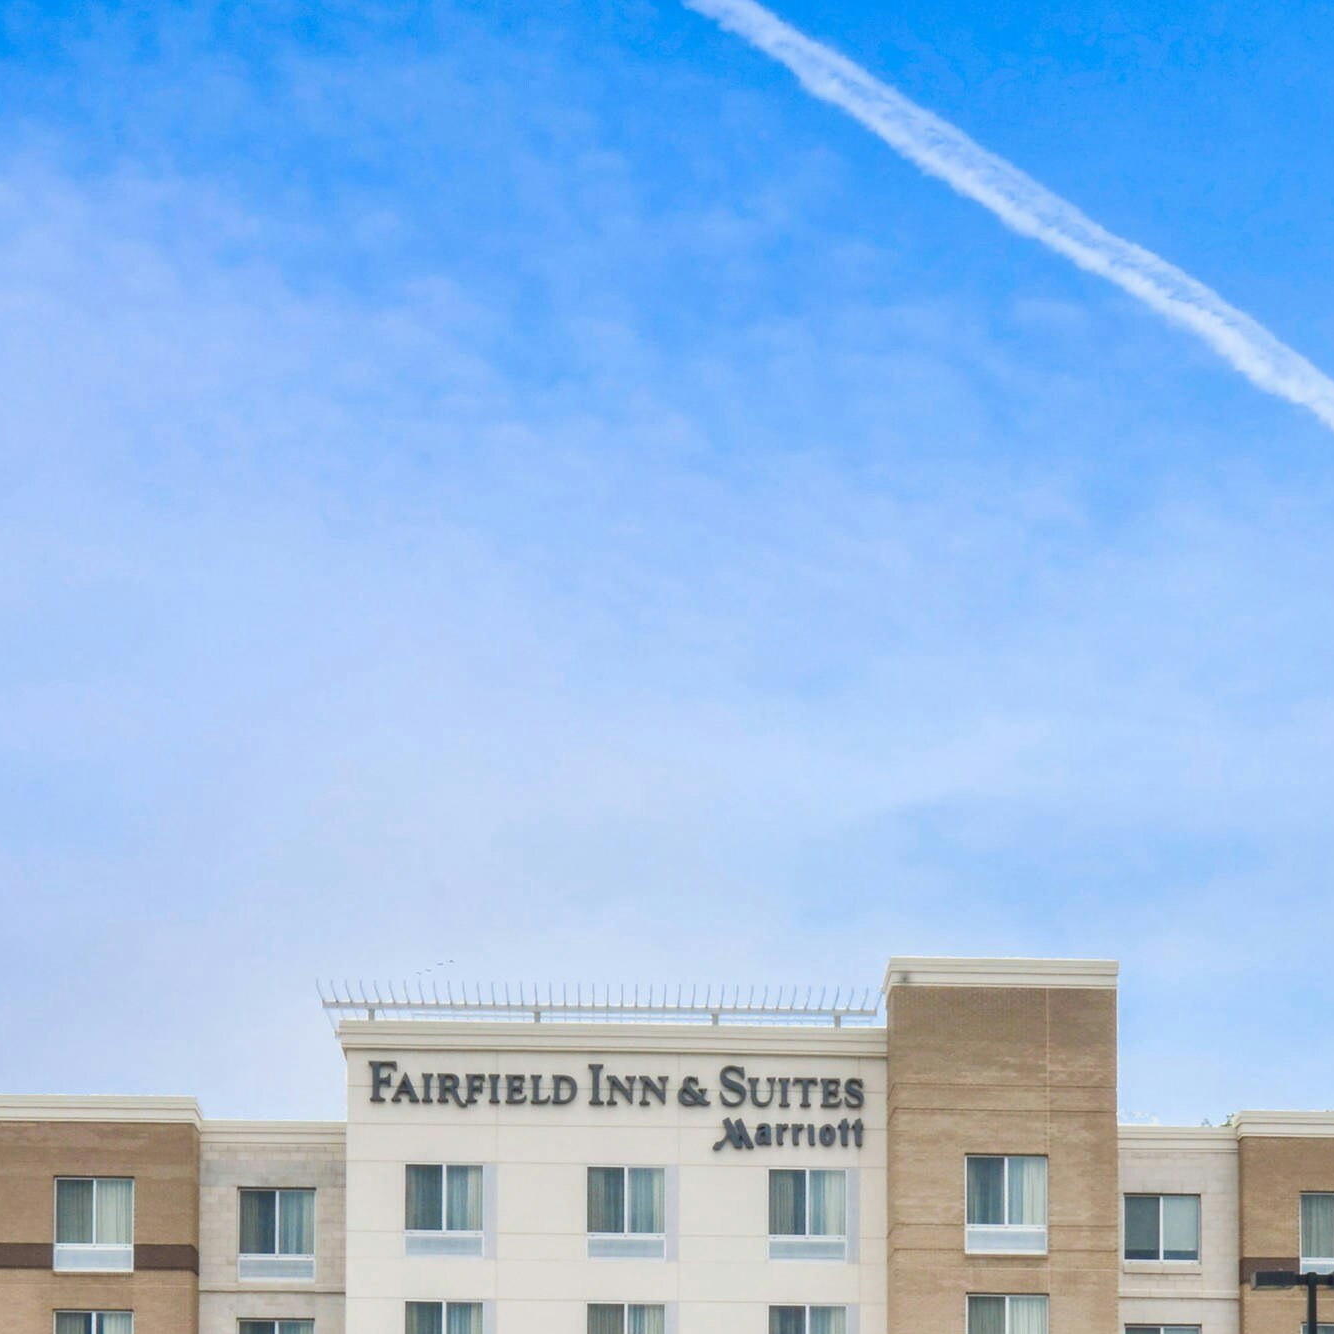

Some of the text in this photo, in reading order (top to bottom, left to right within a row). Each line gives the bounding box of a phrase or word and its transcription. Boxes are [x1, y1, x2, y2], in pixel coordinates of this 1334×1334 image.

[368, 1060, 865, 1108] FAIRFIELD INN & SUITES
[712, 1117, 865, 1151] Marriott
